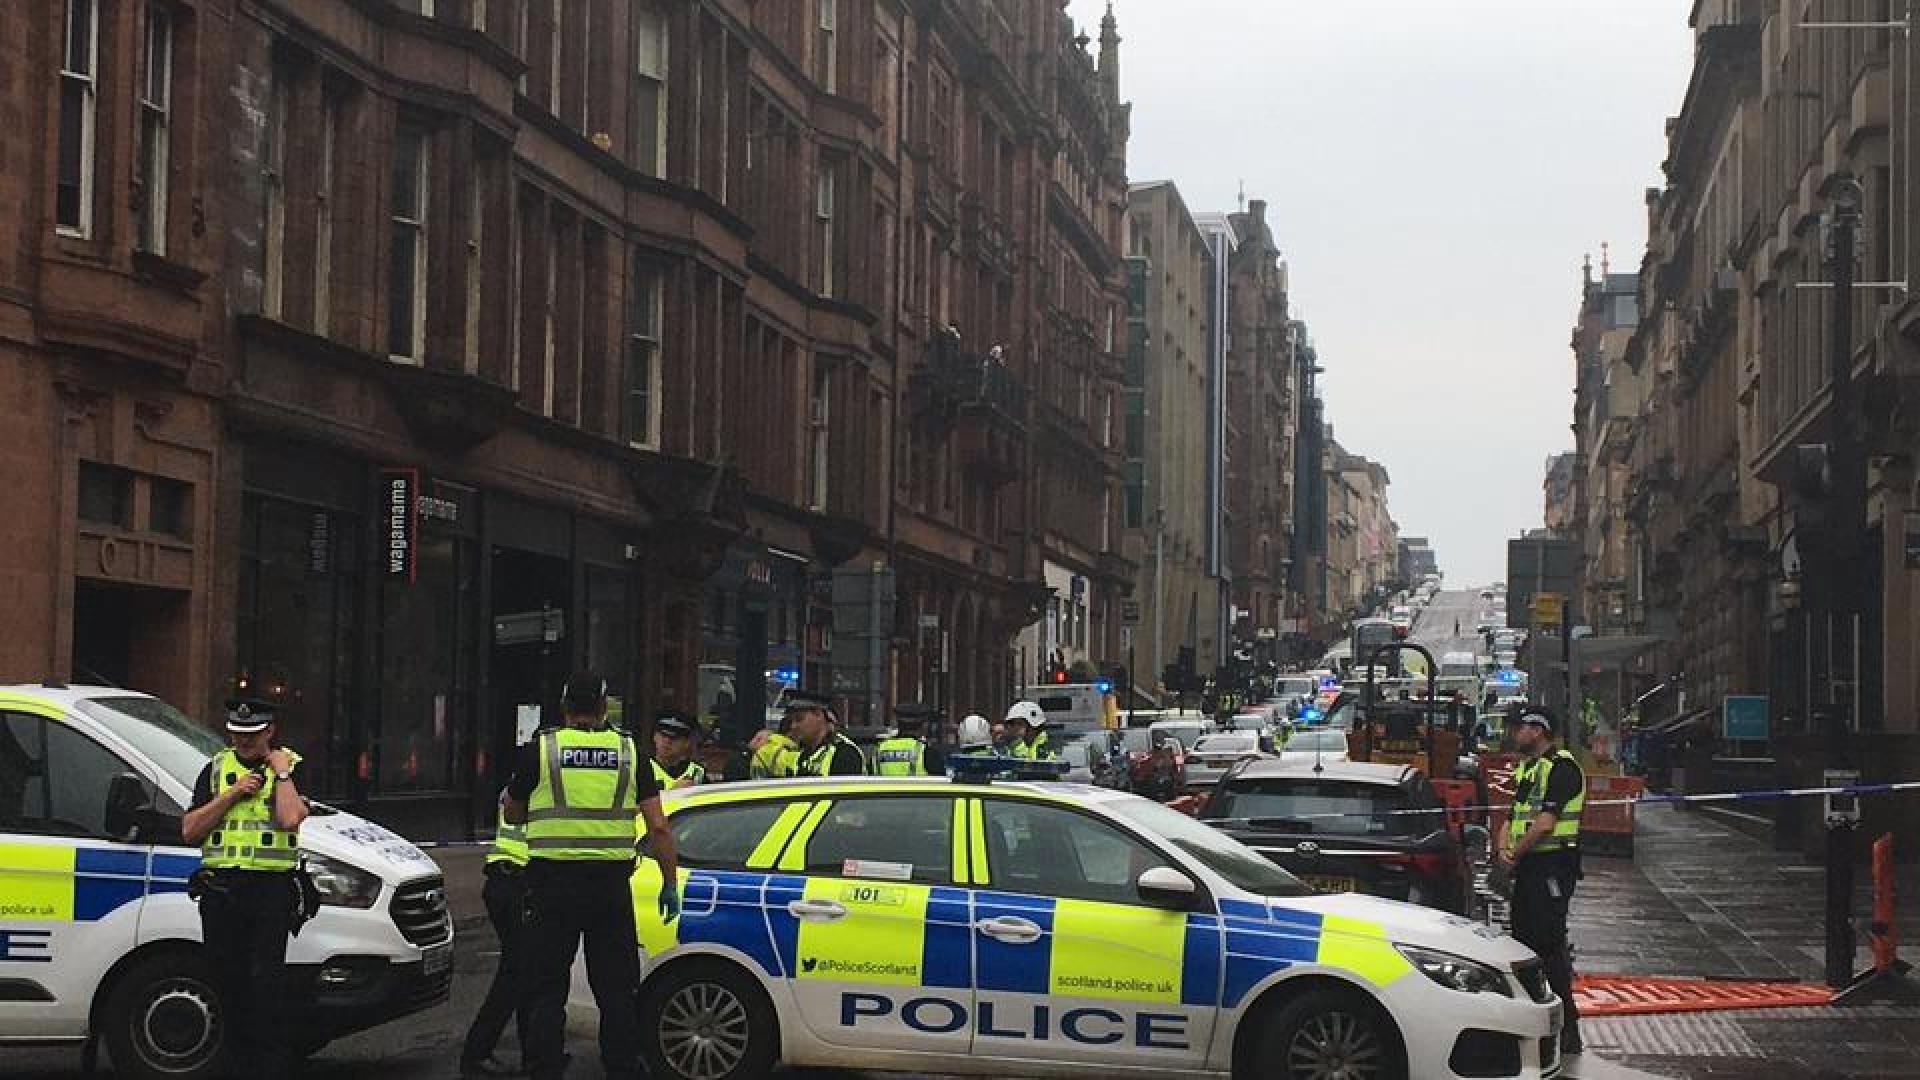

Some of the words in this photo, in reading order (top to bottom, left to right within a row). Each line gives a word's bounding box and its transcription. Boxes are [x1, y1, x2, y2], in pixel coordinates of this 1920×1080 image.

[390, 479, 407, 573] wagamama
[563, 749, 617, 766] POLICE
[854, 887, 879, 901] 101
[817, 959, 917, 977] @PoliceScotland
[840, 992, 1190, 1049] POLICE
